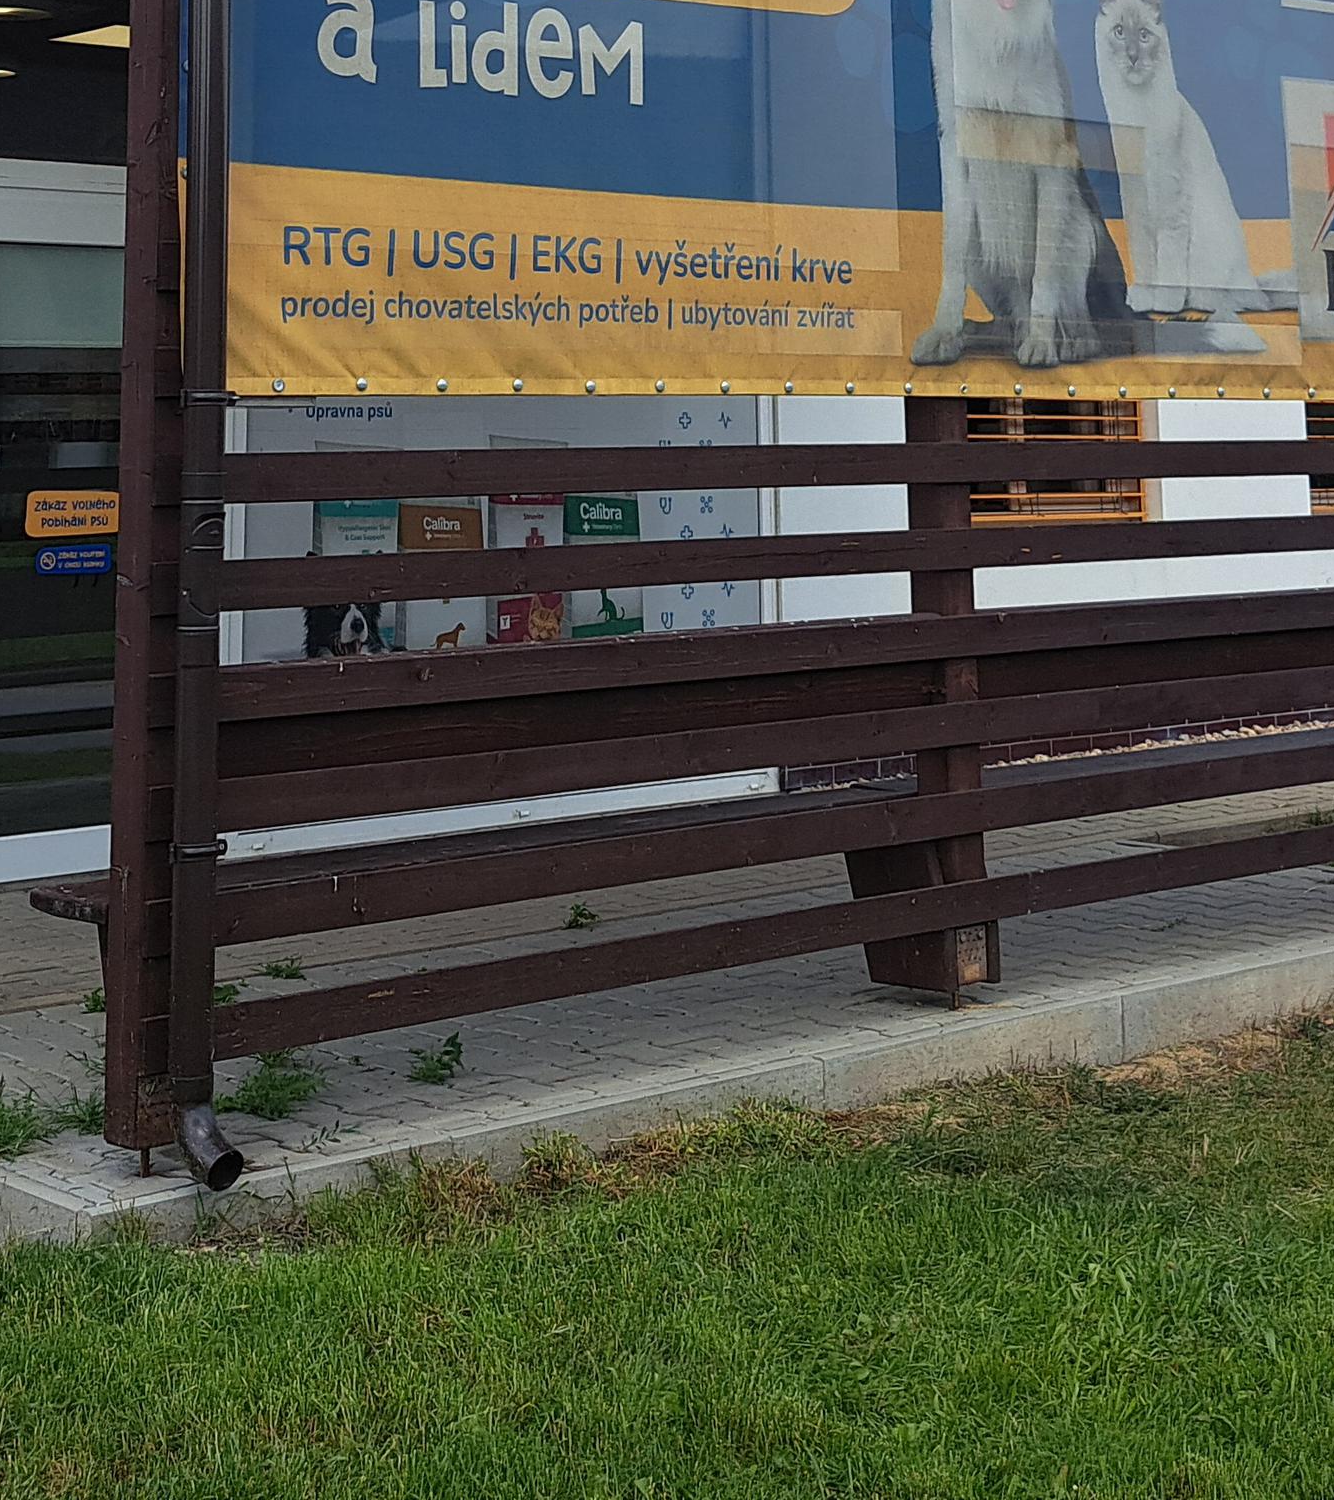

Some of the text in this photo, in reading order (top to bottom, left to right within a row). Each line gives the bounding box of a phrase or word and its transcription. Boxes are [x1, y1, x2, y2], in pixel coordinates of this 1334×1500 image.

[283, 225, 371, 267] RTG
[413, 229, 495, 270] USG
[532, 235, 601, 274] EKG
[636, 239, 783, 285] vyšetření
[792, 248, 853, 285] krve
[281, 290, 375, 324] prodej
[384, 290, 570, 327] chovatelských
[579, 295, 659, 328] potřeb
[682, 299, 791, 331] ubytování
[797, 302, 855, 329] zvířat
[306, 401, 393, 422] Upravna psů
[580, 502, 622, 520] Calibra
[423, 516, 461, 531] Calibra
